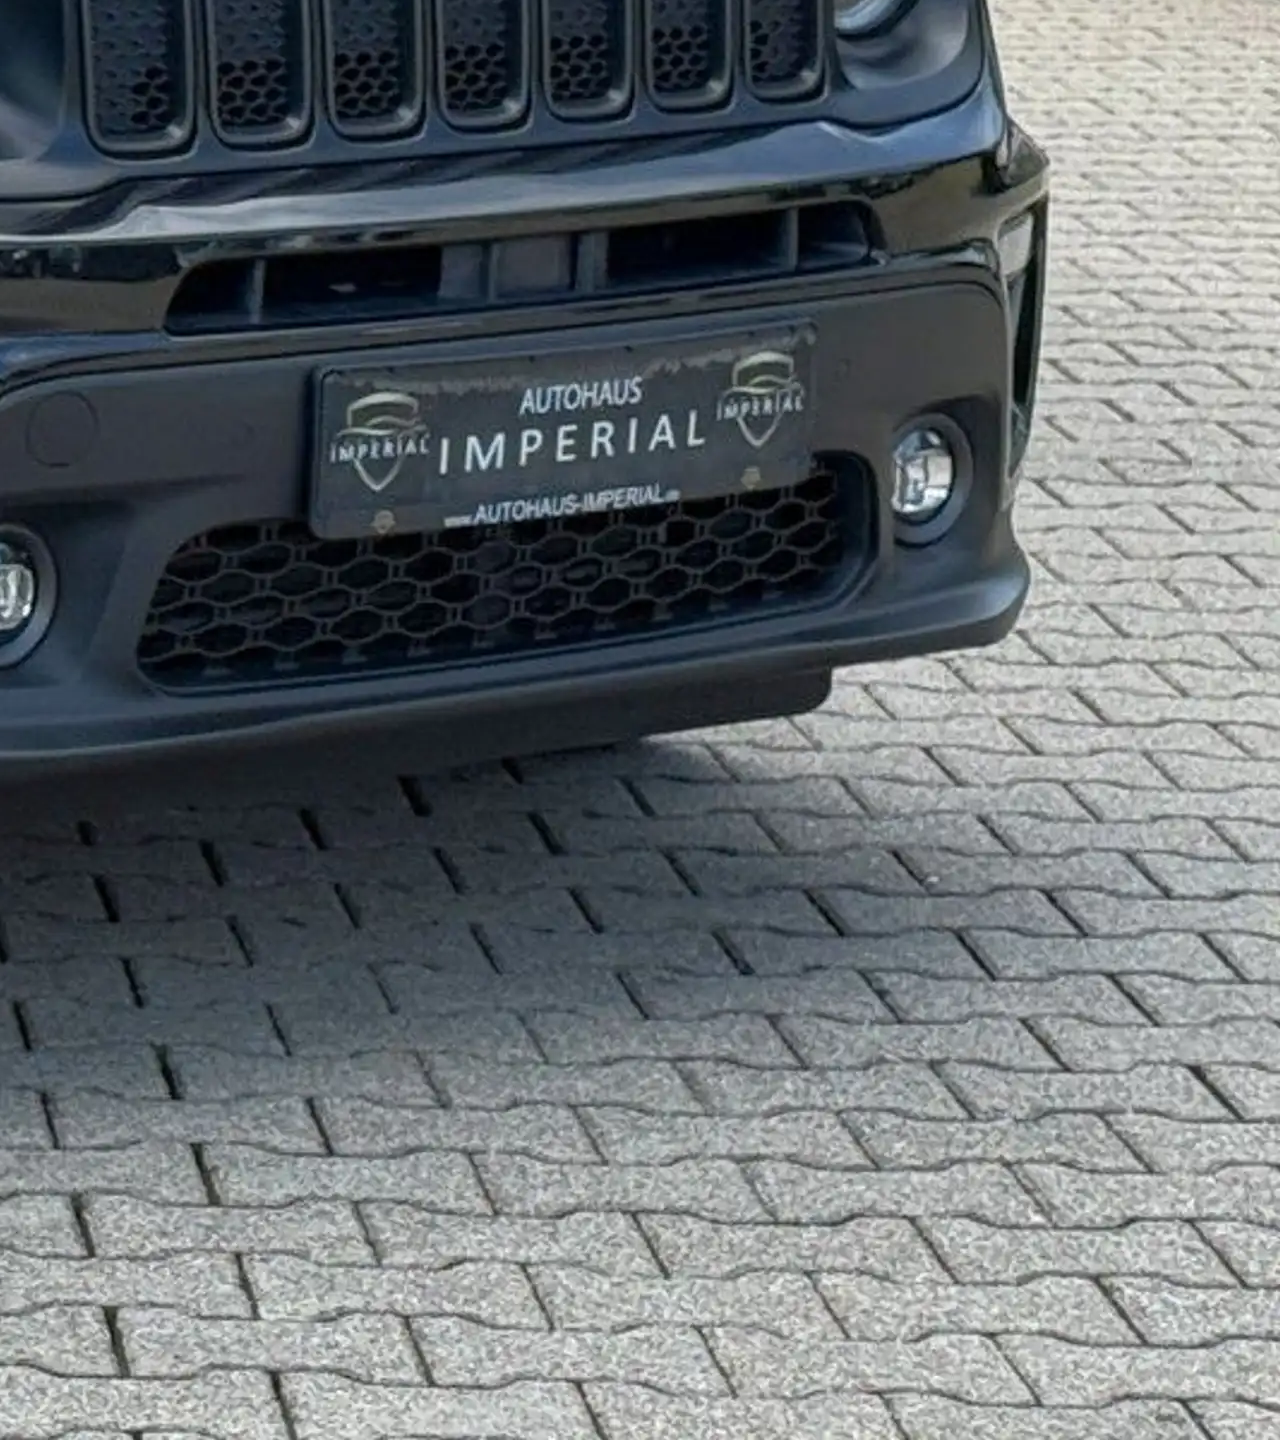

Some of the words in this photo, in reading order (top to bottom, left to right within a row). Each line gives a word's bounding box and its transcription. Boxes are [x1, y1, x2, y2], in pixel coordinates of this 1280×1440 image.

[519, 376, 643, 415] AUTOHAUS
[439, 409, 706, 475] IMPERIAL
[444, 482, 681, 528] AUTOHAUS-IMPERIAL
